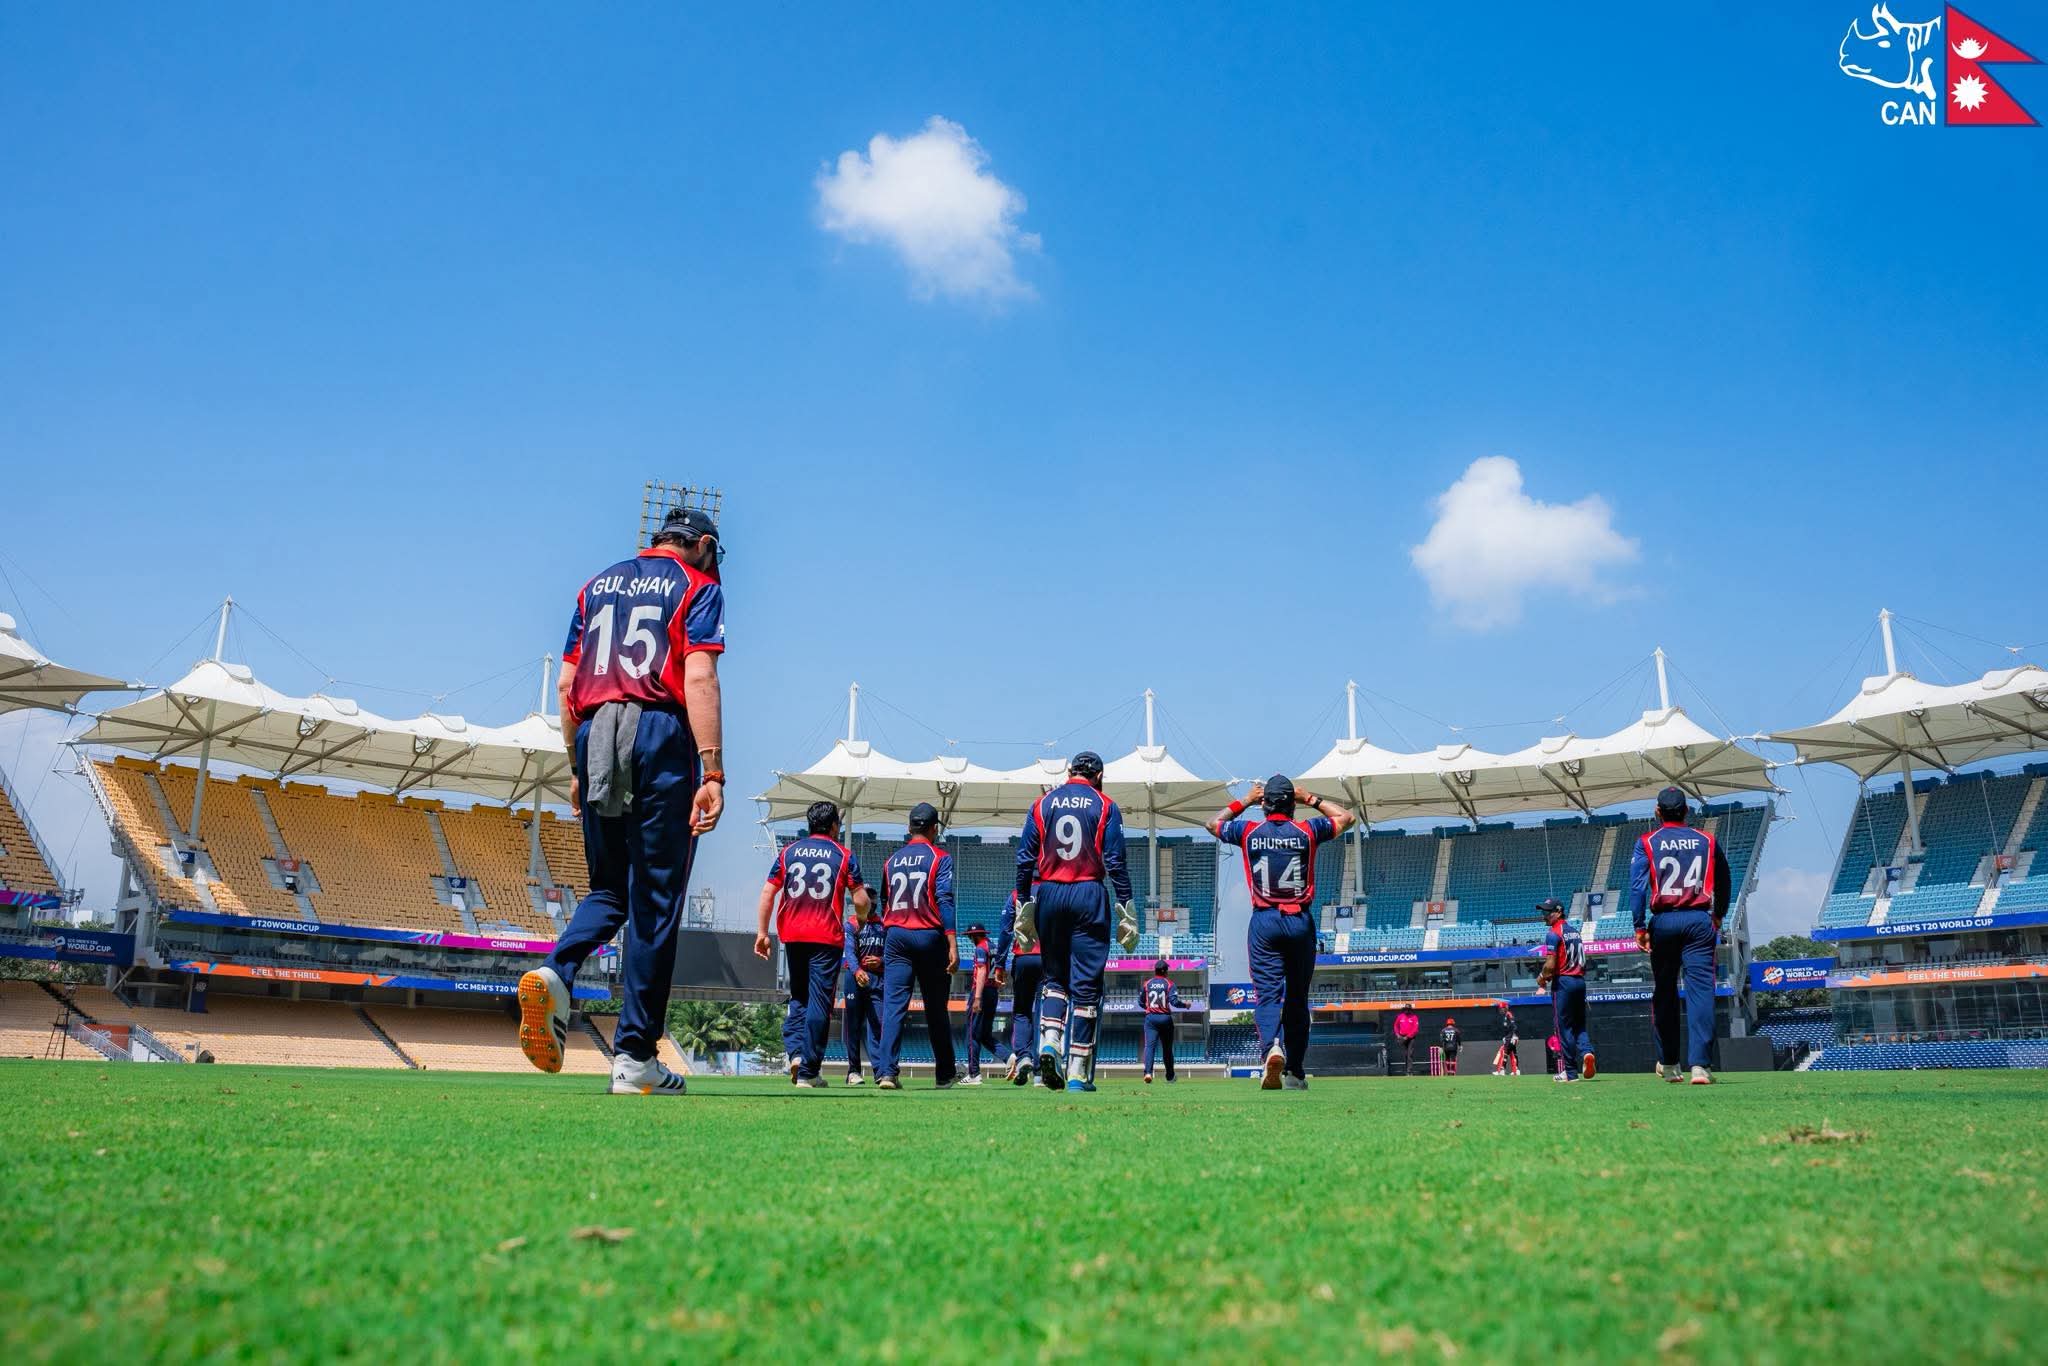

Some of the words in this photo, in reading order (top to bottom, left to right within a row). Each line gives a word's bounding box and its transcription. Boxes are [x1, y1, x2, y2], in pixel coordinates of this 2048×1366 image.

[592, 576, 677, 597] GULSHAN
[588, 604, 662, 679] 15
[1050, 797, 1093, 809] AASIF
[1055, 815, 1082, 861] 9
[1251, 837, 1305, 850] BHURTEL
[1660, 839, 1700, 851] AARIF
[794, 847, 832, 858] KARAN
[894, 855, 924, 867] LALIT
[787, 862, 832, 900] 33
[1253, 856, 1306, 897] 14
[1659, 855, 1703, 896] 24
[891, 871, 928, 911] 27
[251, 919, 320, 932] #T20WORLDCUP
[1876, 926, 1892, 935] ICC
[1893, 924, 1920, 933] MEN'S
[1921, 922, 1938, 931] T20
[1939, 919, 1973, 929] WORLD
[1974, 918, 1994, 927] CUP
[67, 942, 95, 951] WORLD
[491, 940, 526, 949] CHENNAI
[1584, 944, 1604, 952] FEEL
[1342, 954, 1417, 963] T20WORLDCUP.COM
[251, 968, 273, 976] FEEL
[274, 970, 291, 978] THE
[292, 971, 321, 980] THRILL
[1907, 973, 1931, 981] FEEL
[1932, 972, 1950, 980] THE
[1951, 970, 1985, 978] THRILL
[455, 982, 469, 990] ICC
[469, 983, 494, 992] MEN'S
[495, 985, 509, 993] T20
[1148, 990, 1167, 1009] 21
